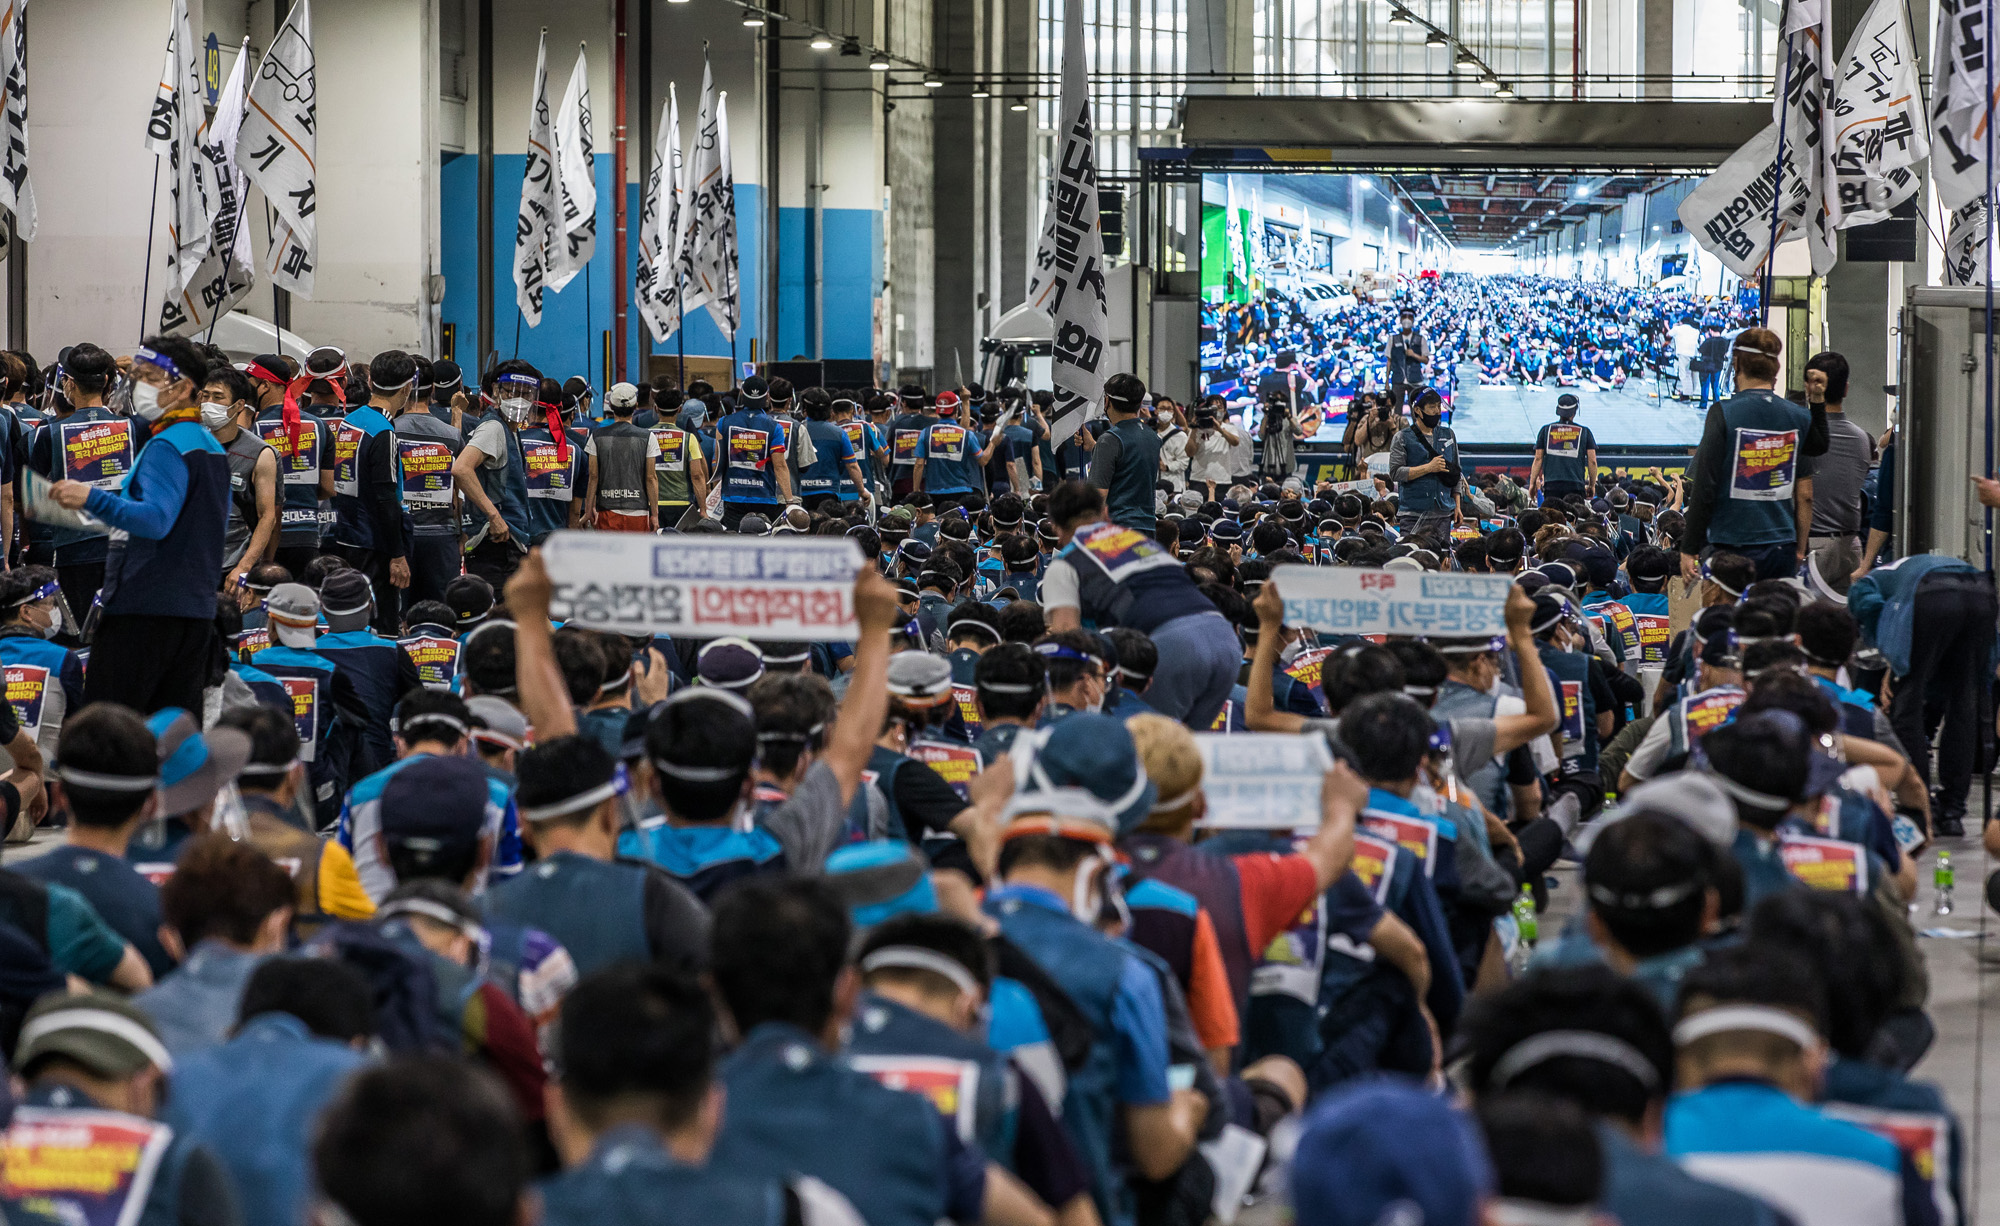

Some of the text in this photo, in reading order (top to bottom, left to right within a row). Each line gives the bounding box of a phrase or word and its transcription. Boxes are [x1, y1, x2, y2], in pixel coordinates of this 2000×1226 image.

[207, 48, 218, 90] 48
[81, 426, 111, 441] 분류작업
[98, 432, 129, 445] 책임지고
[411, 446, 438, 457] 분류작업
[536, 447, 557, 456] 분류작
[426, 455, 452, 464] 책임지고
[281, 510, 317, 523] 연대노조
[5, 671, 24, 682] 작업
[5, 690, 36, 700] 행하라!
